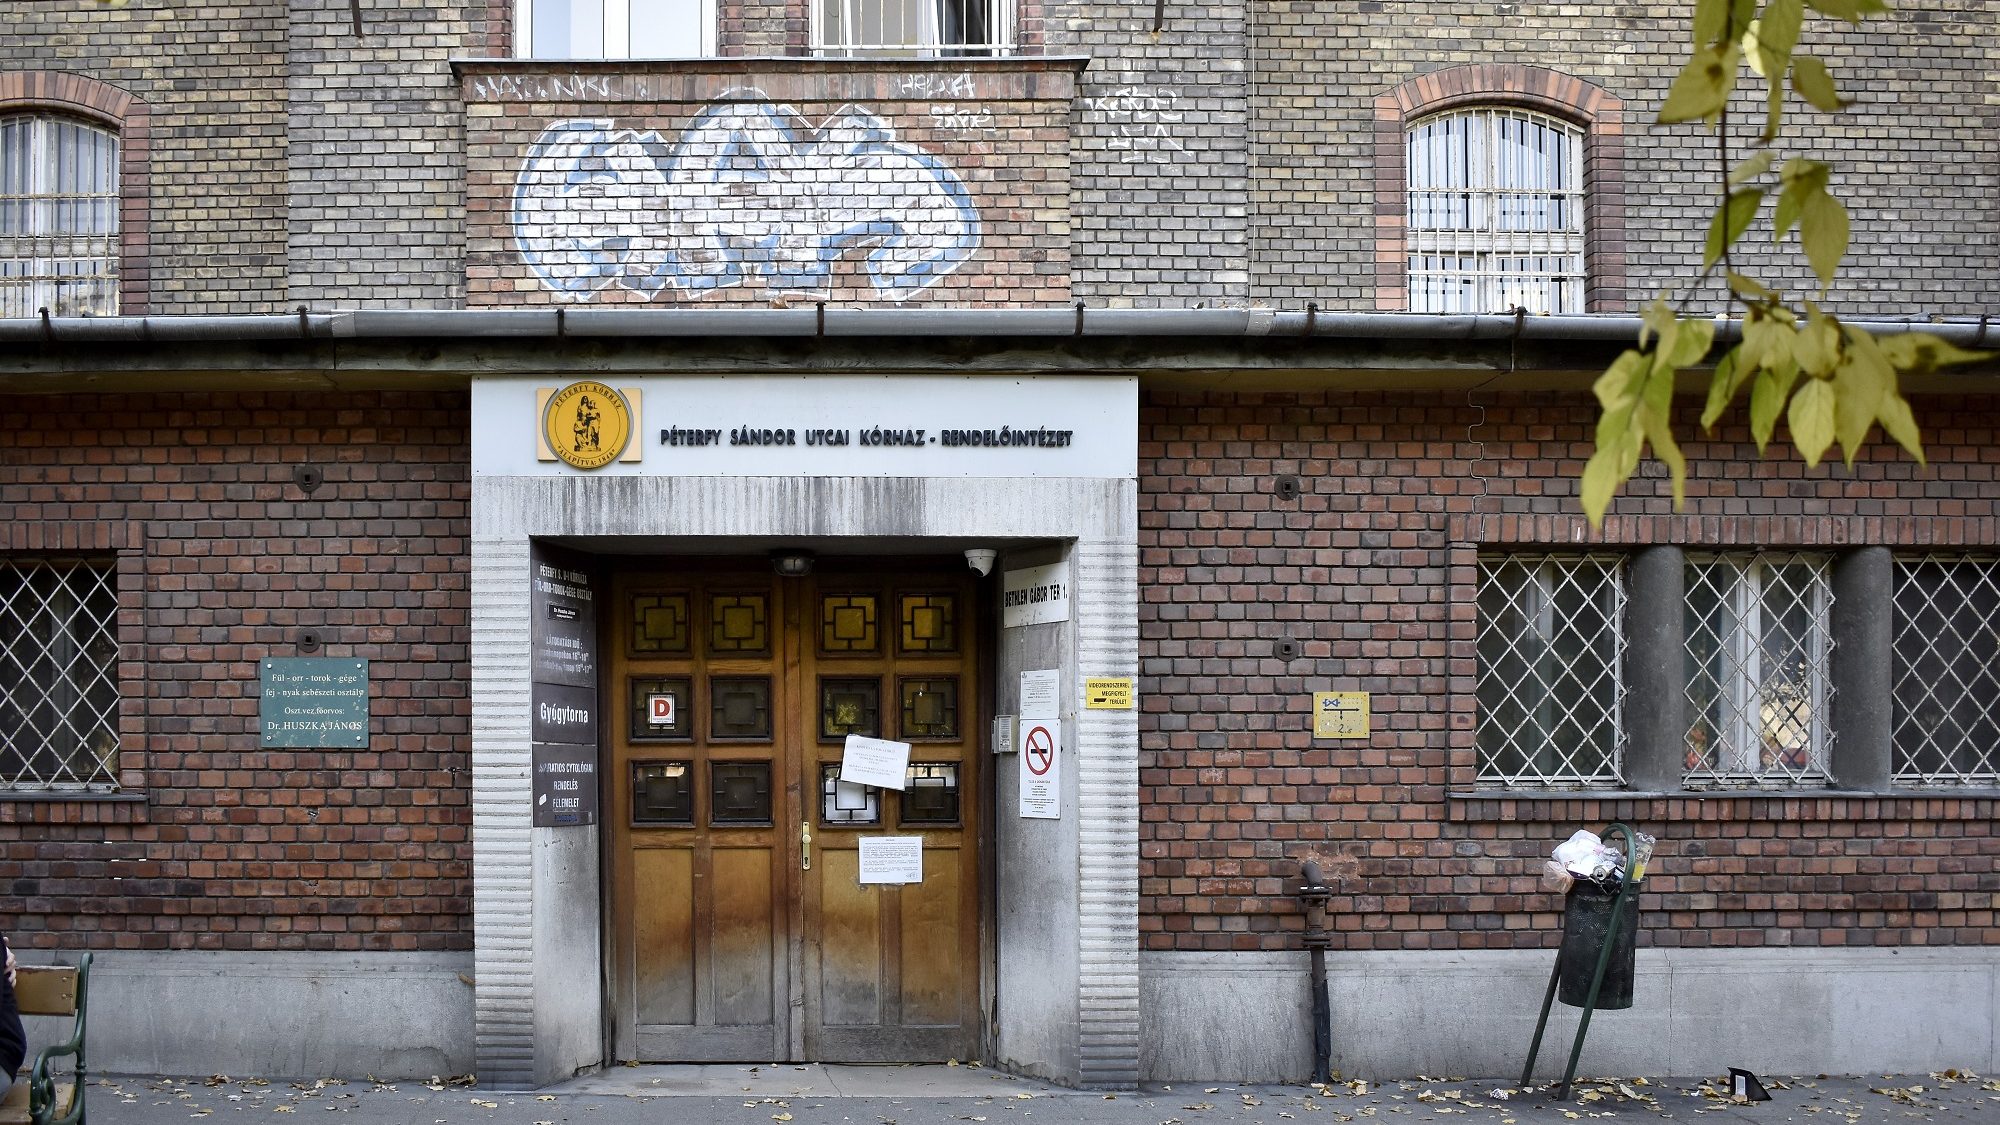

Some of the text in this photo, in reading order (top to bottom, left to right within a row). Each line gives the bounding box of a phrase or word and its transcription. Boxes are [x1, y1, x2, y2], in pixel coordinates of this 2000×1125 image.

[660, 425, 722, 446] PÉTERFY
[730, 424, 796, 446] SÁNDOR
[805, 429, 850, 446] UTCAI
[941, 425, 1074, 448] RENDELŐINTÉZET
[1004, 580, 1068, 608] BETHLEN GÁBOR TÉR 1.
[272, 674, 285, 682] Fül
[311, 674, 331, 682] torok
[265, 688, 275, 697] fej
[282, 689, 300, 698] nyak
[540, 702, 589, 725] Gyógytorna
[654, 699, 671, 717] D
[267, 719, 362, 730] Dr. HUSZKA JÁNOS
